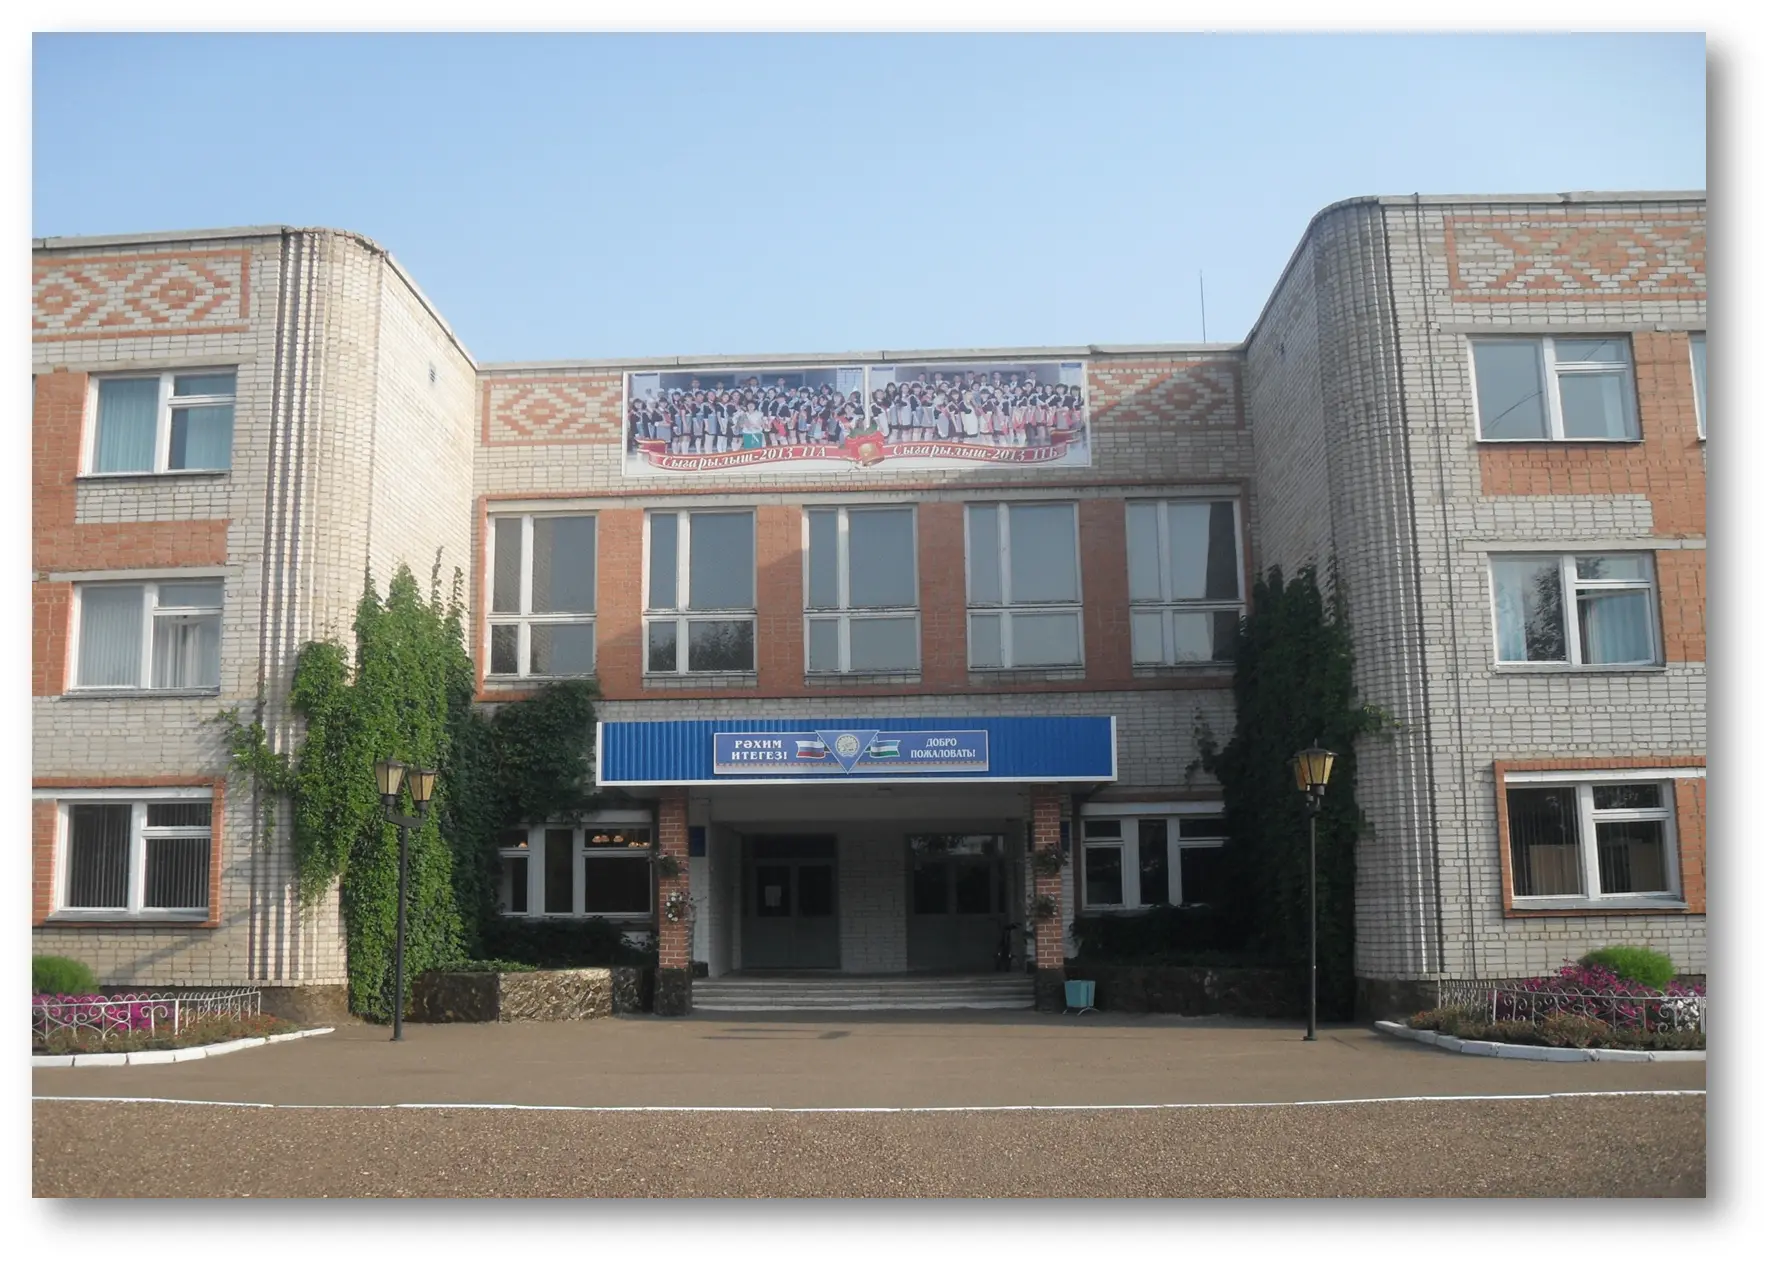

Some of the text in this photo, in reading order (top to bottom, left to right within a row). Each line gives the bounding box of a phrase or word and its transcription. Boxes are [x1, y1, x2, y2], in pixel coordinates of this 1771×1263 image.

[734, 739, 782, 749] РӘХИМ
[925, 737, 958, 748] ДОБРО
[910, 748, 976, 759] ПОЖАЛОВАТЬ!
